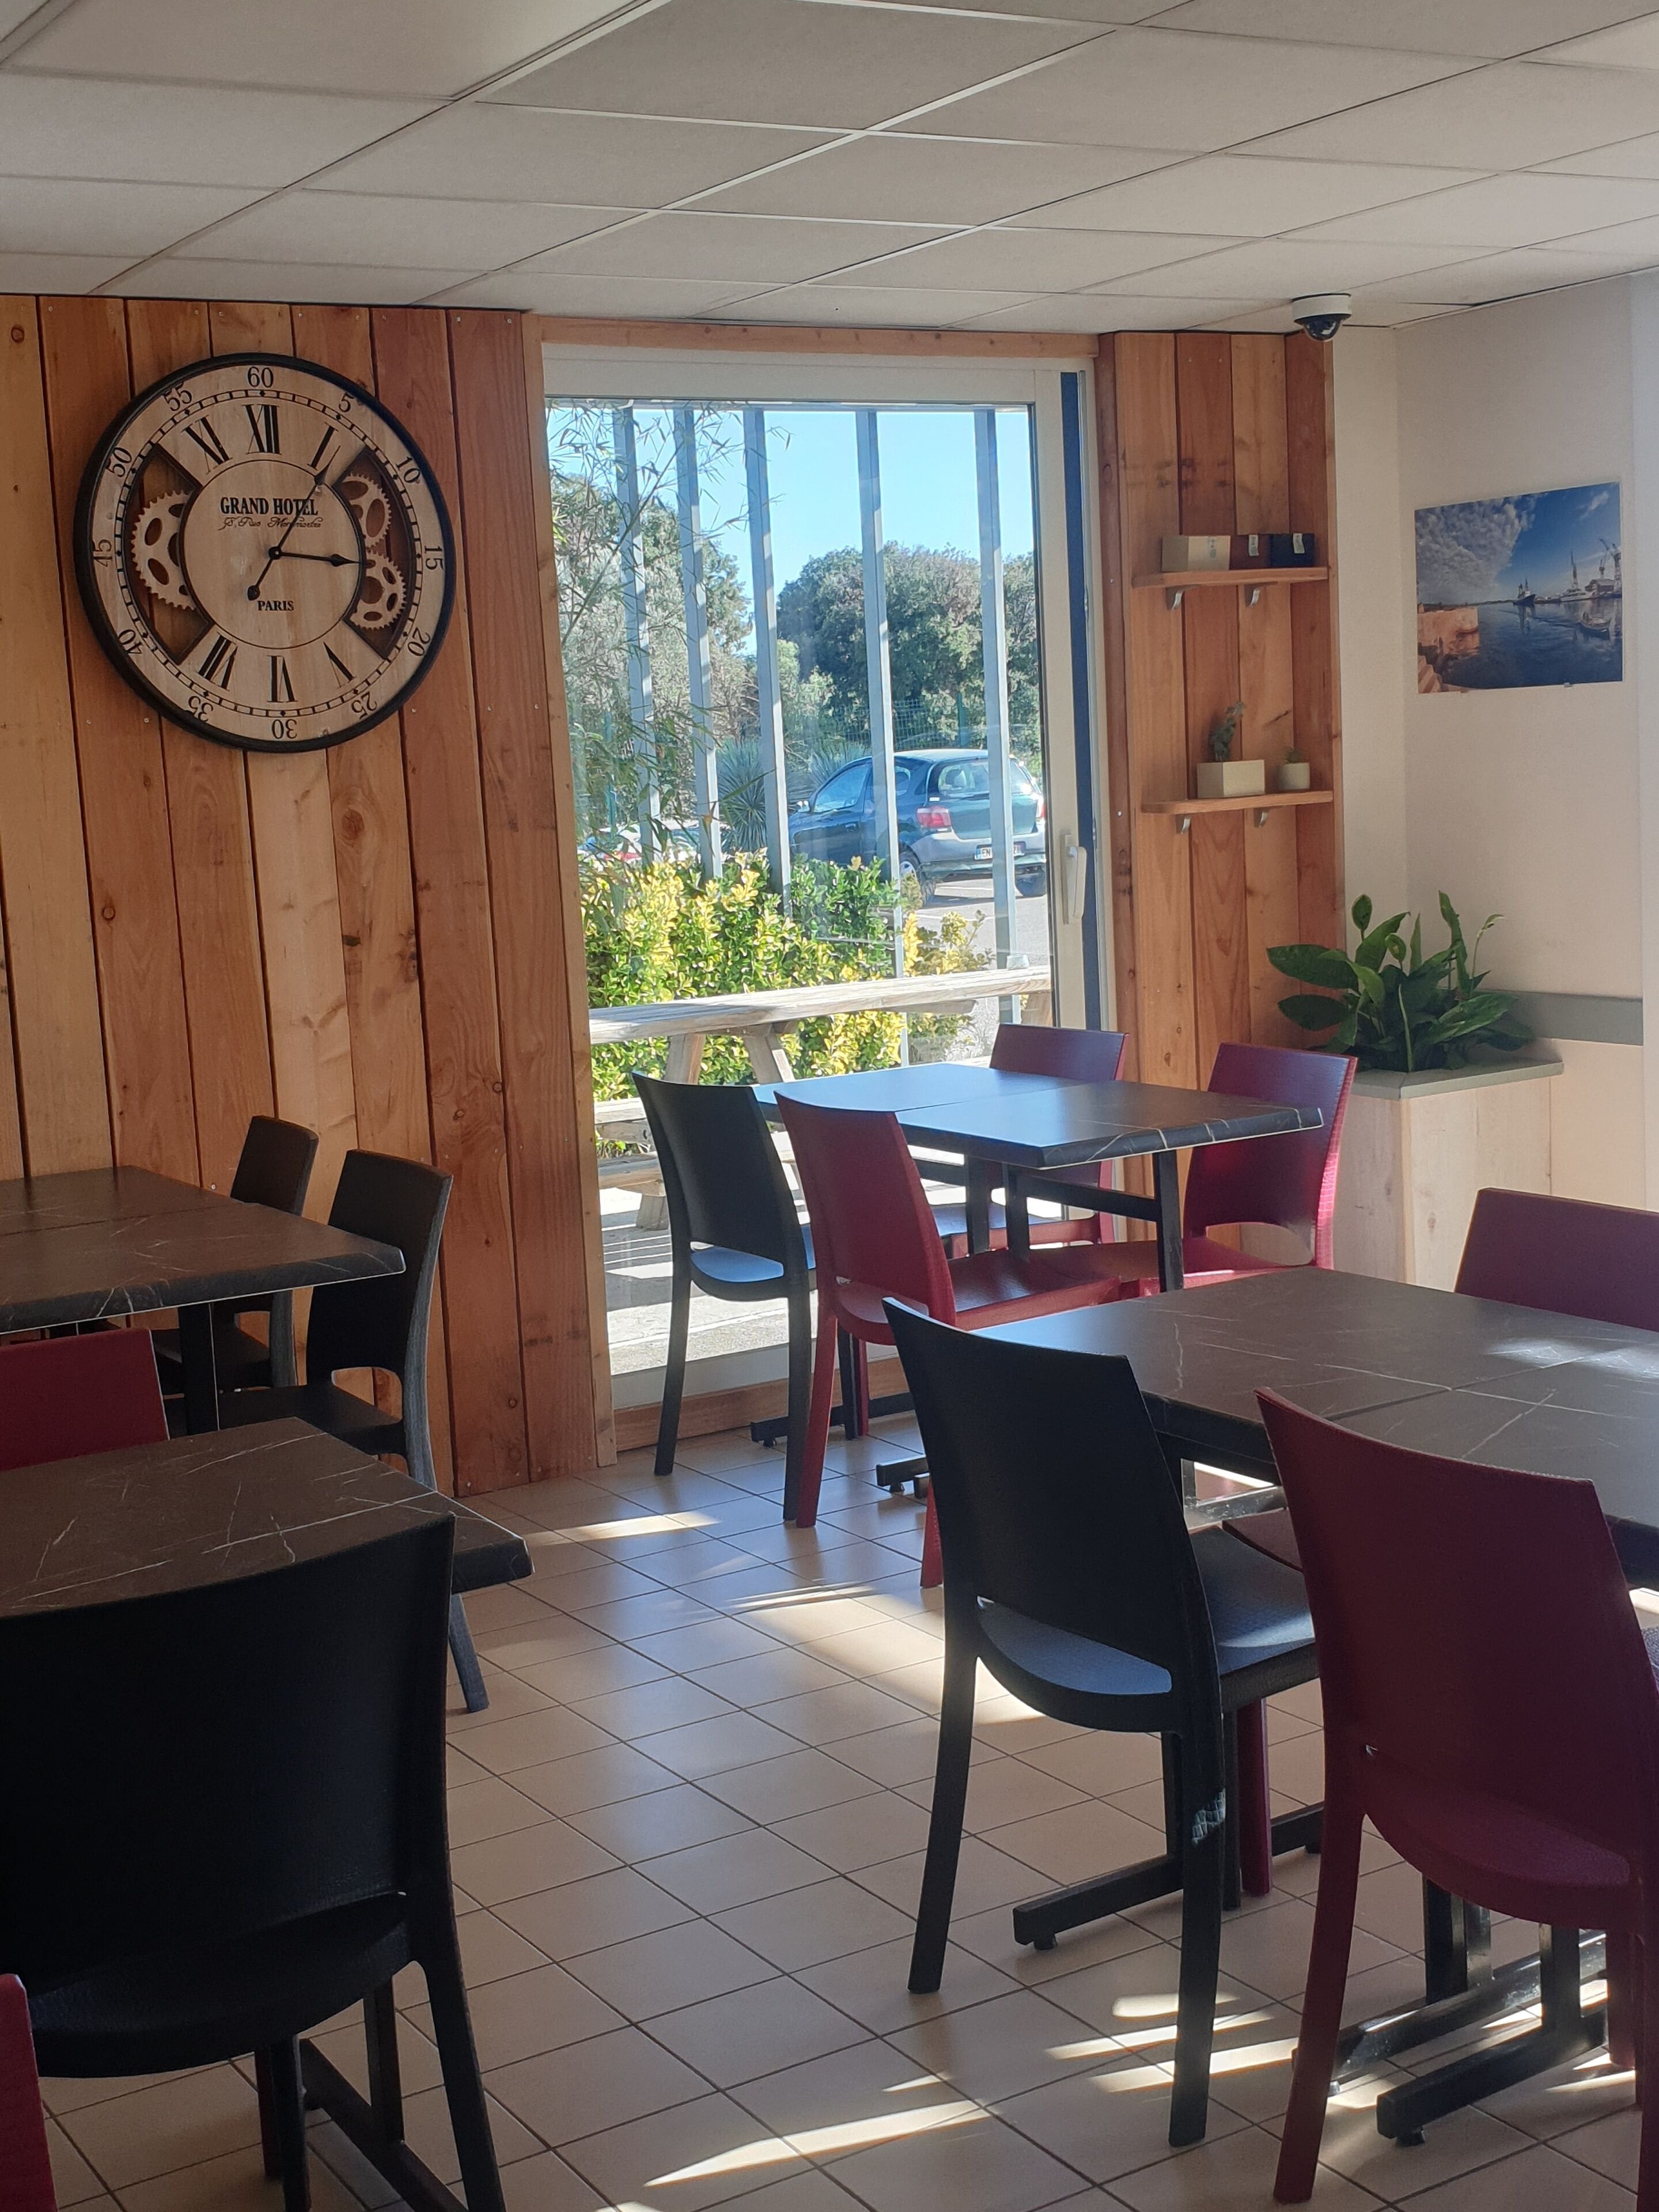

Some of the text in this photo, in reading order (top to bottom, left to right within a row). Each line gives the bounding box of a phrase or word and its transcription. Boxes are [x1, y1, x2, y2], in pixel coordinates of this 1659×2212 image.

[248, 366, 274, 388] 60
[163, 381, 192, 411] 55
[338, 392, 354, 413] 5
[242, 404, 282, 455] XII
[181, 415, 233, 475] XI
[306, 422, 339, 471] I
[105, 447, 132, 478] 50
[396, 456, 421, 483] 10
[221, 497, 318, 516] GRAND HOTEL
[93, 539, 112, 567] 45
[425, 546, 444, 571] 15
[256, 600, 294, 611] PARIS
[118, 629, 143, 654] 40
[407, 627, 431, 656] 20
[196, 631, 238, 691] VII
[323, 641, 357, 690] V
[267, 655, 298, 703] VI
[188, 695, 214, 722] 35
[351, 691, 377, 719] 25
[271, 719, 298, 739] 30
